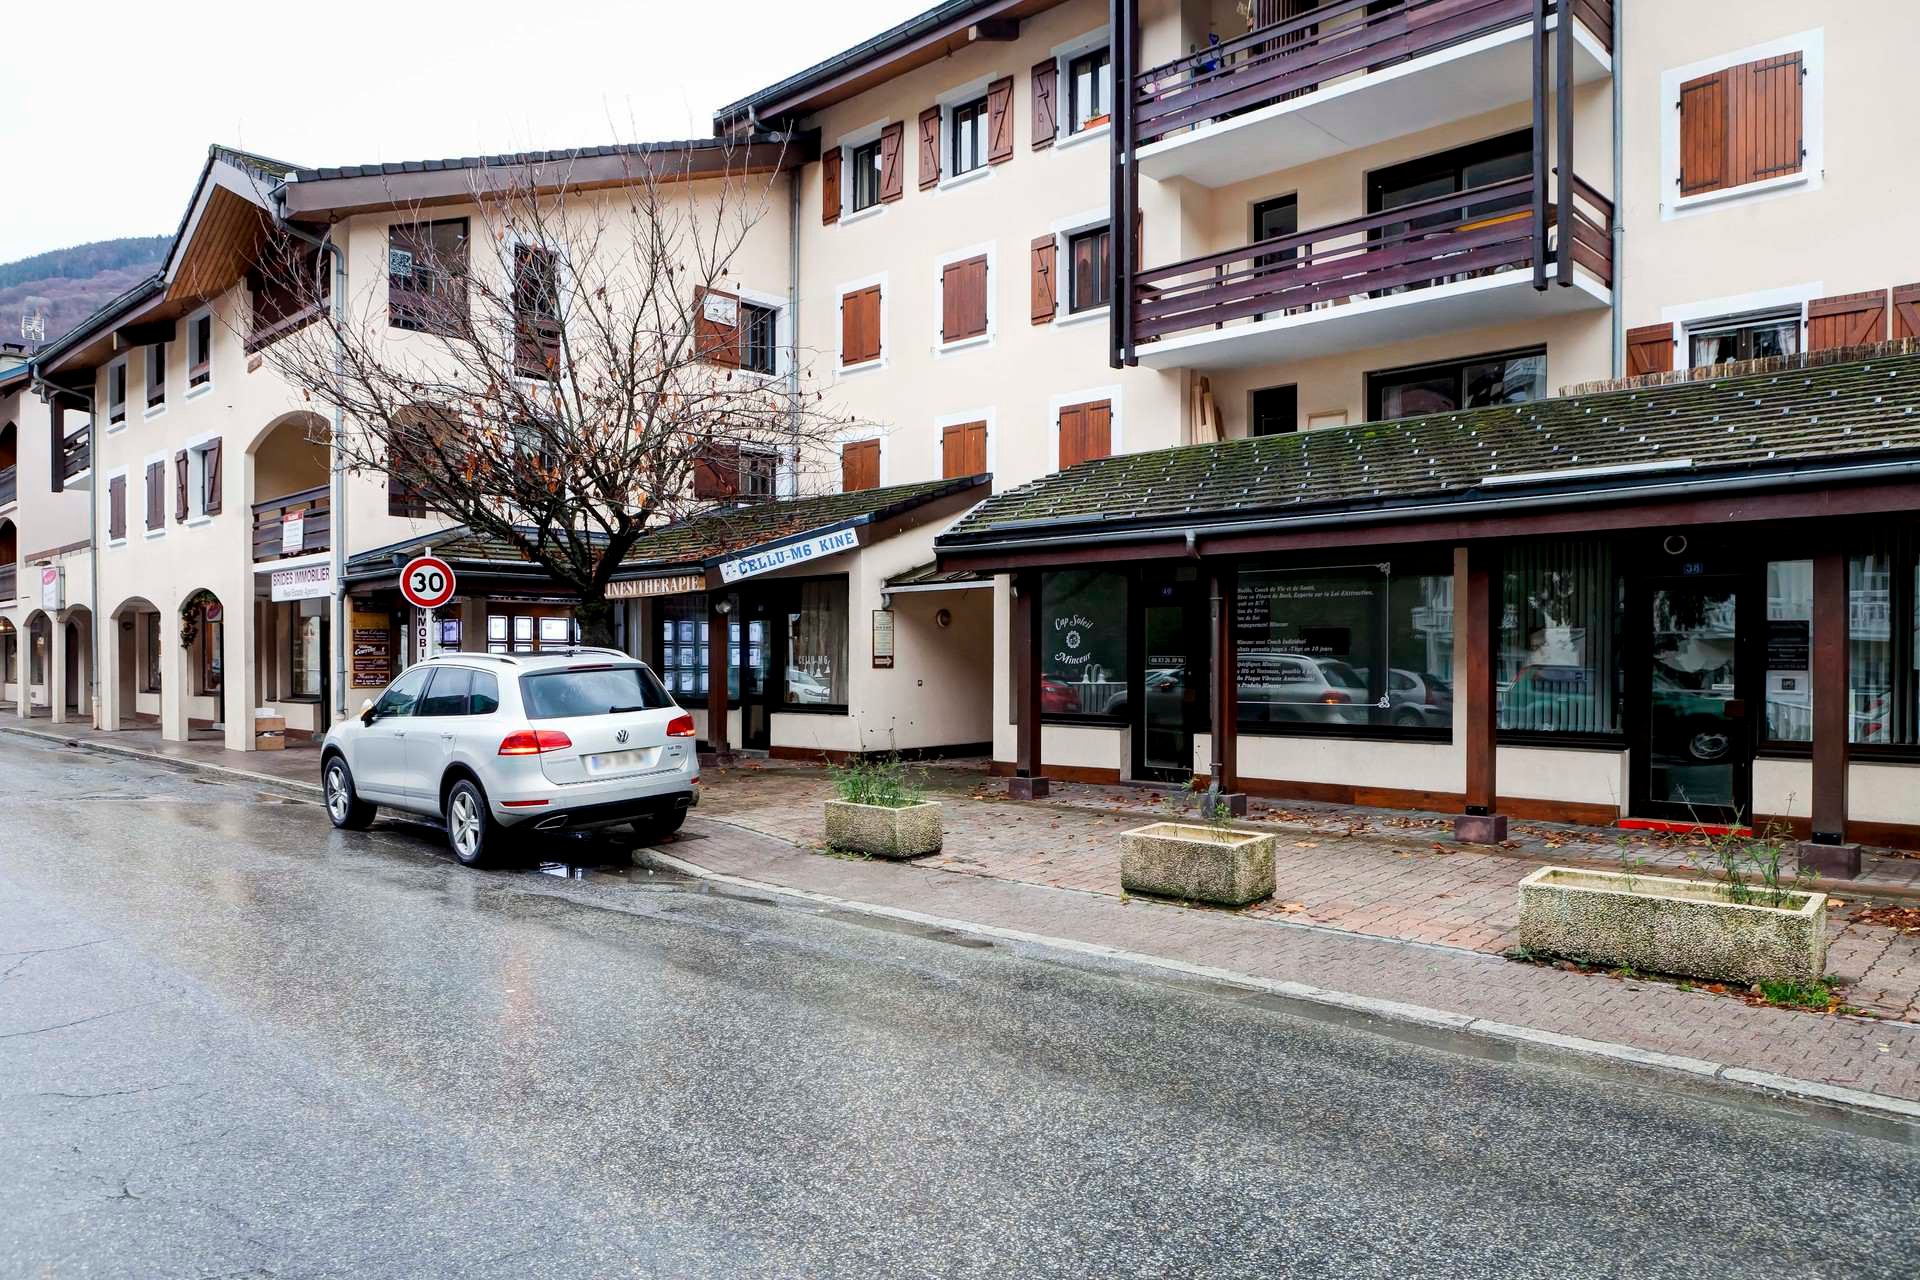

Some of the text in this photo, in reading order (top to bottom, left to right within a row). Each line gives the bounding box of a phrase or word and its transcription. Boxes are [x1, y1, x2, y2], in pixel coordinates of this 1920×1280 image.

[738, 532, 855, 576] CELLU-M6 KINE
[273, 568, 330, 586] BRIDES IMMOBILIER
[413, 572, 444, 593] 30
[606, 575, 700, 598] INESITHERAPIE
[1055, 614, 1094, 630] Cap Soleil
[418, 608, 428, 662] MMOBI
[1054, 652, 1092, 664] Minceur
